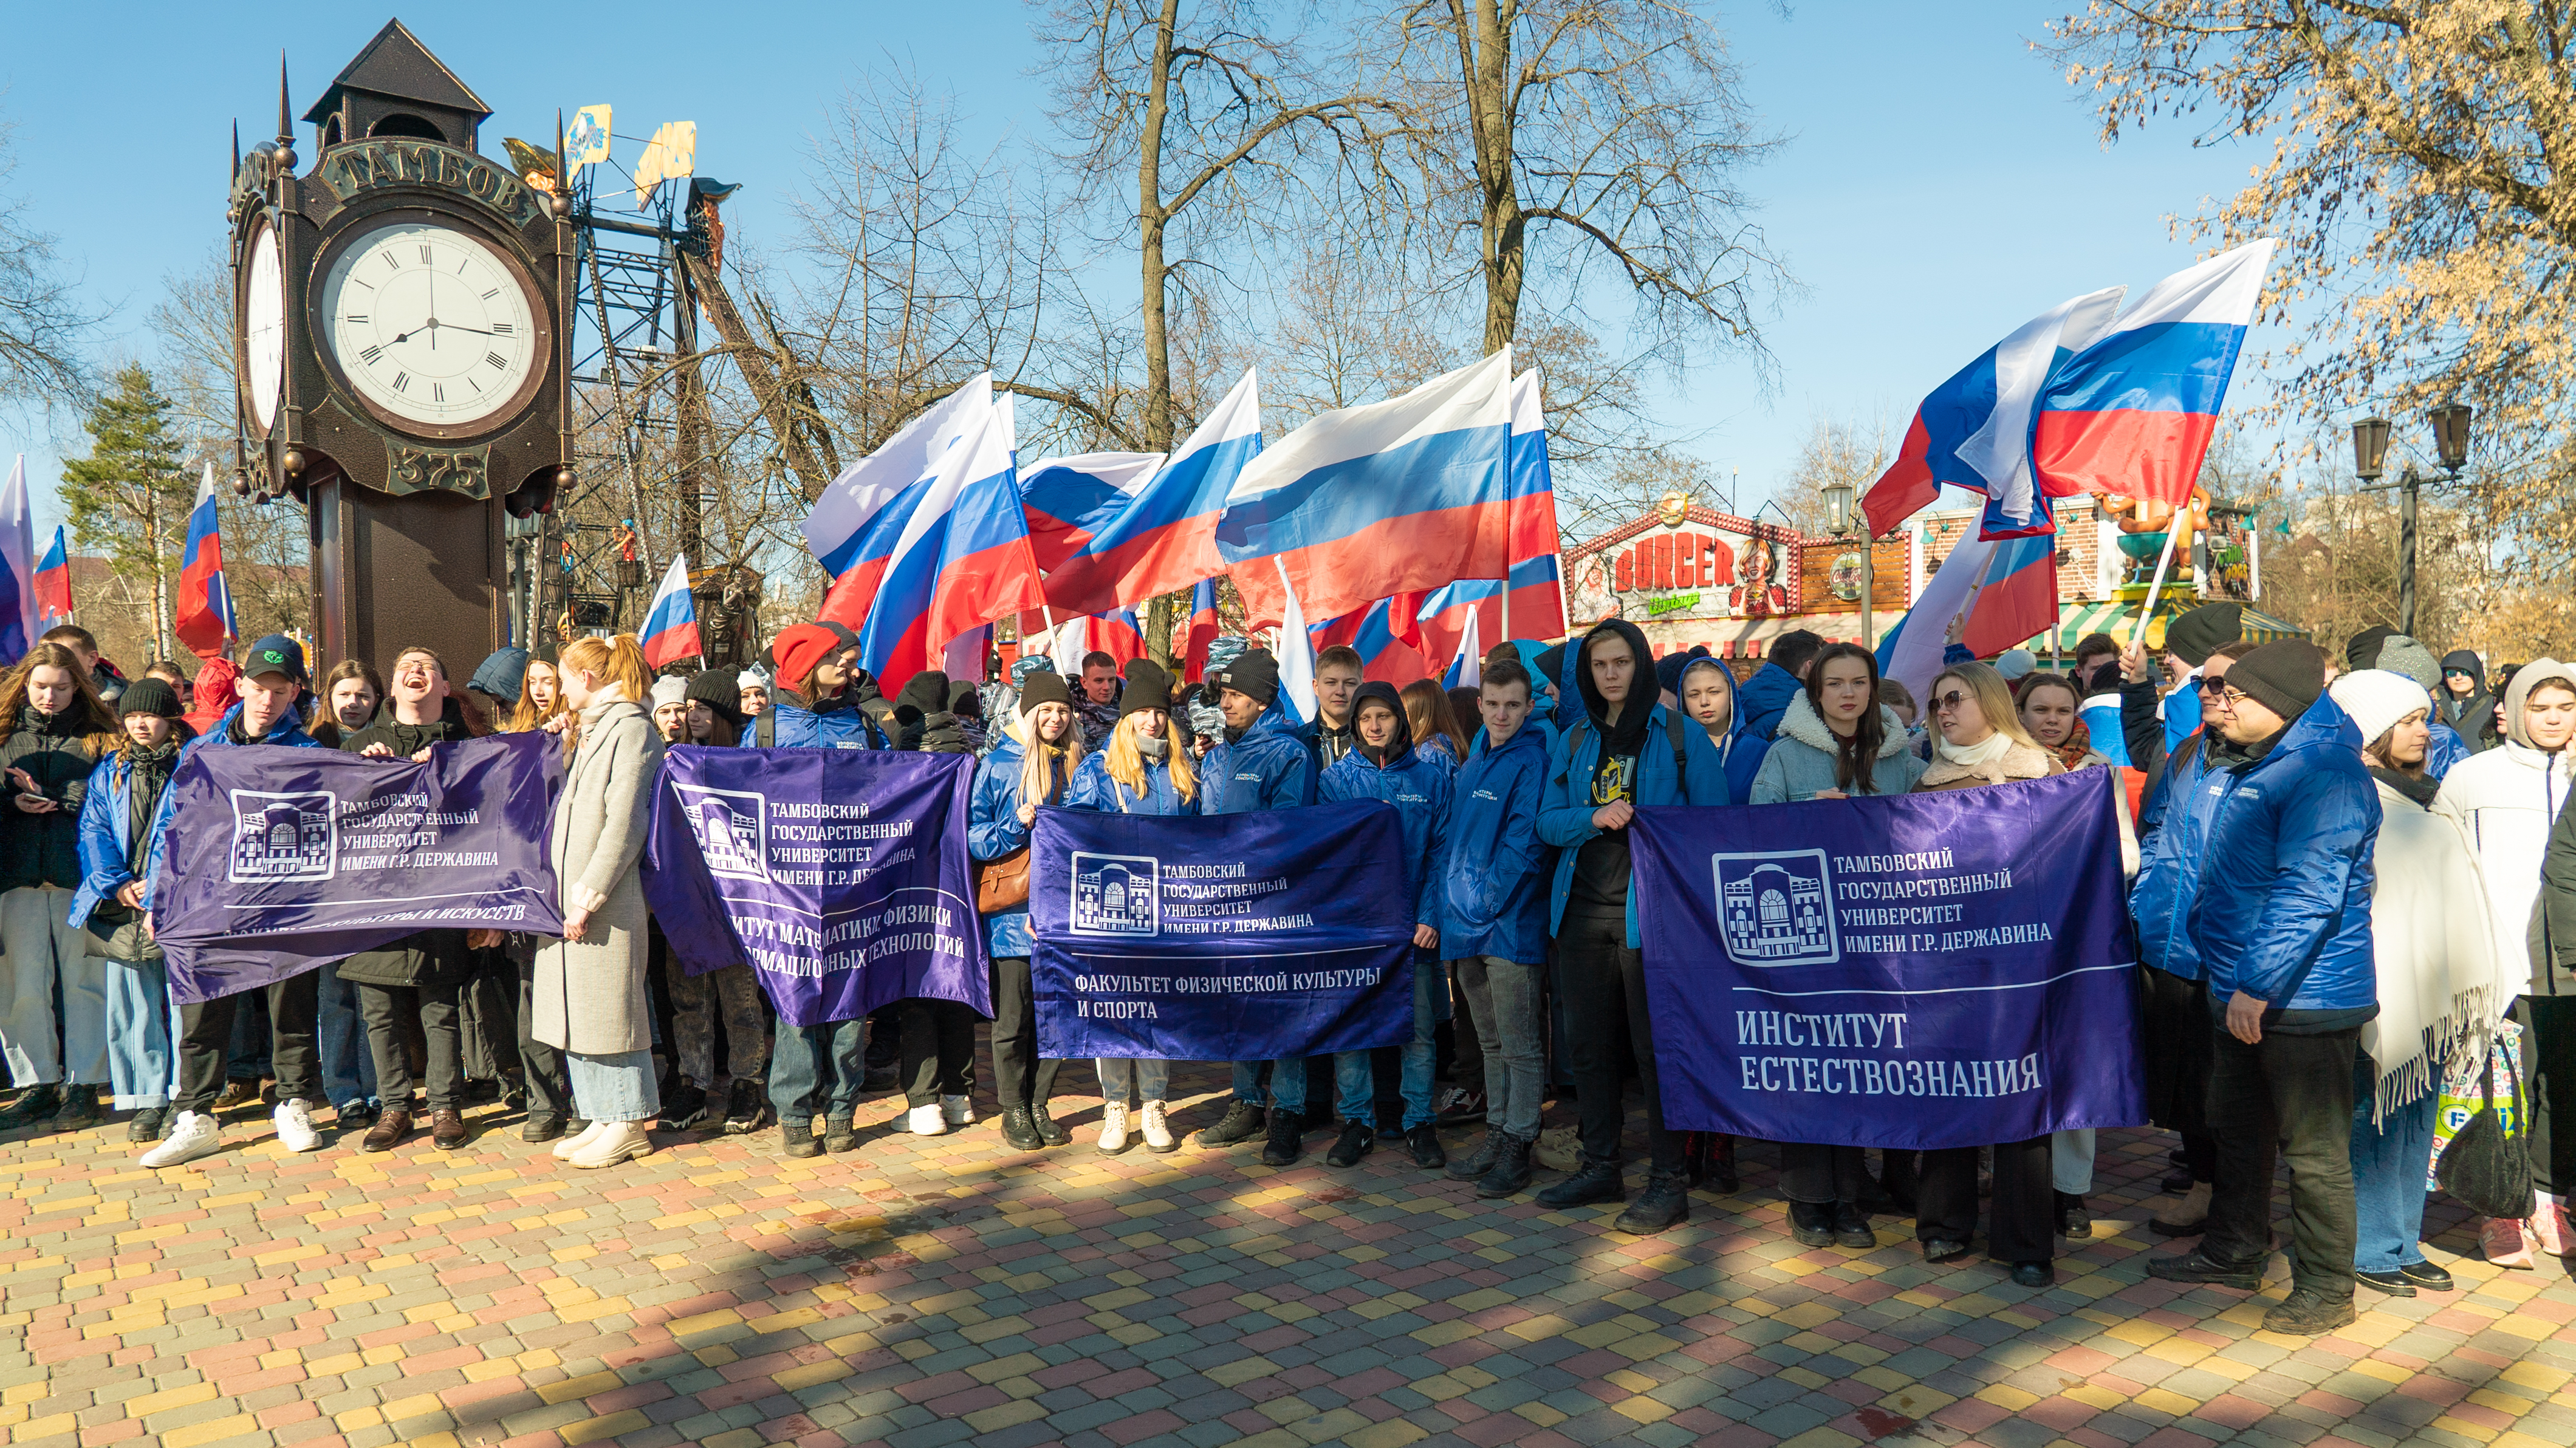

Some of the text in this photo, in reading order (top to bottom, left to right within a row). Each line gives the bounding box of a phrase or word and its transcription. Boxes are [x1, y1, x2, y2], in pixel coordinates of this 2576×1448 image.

[332, 145, 521, 213] ТАМБОВ
[397, 447, 477, 488] 375
[1615, 531, 1736, 593] BURGER
[2225, 563, 2248, 582] DOGS
[341, 791, 428, 814] ТАМБОВСКИЙ
[770, 802, 869, 819] ТАМБОВСКИЙ
[343, 808, 479, 829] ГОСУДАРСТВЕННЫЙ
[771, 819, 914, 842] ГОСУДАРСТВЕННЫЙ
[341, 852, 499, 872] ИМЕНИ Г.Р. ДЕРЖАВИНА
[771, 847, 872, 863] УНИВЕРСИТЕТ
[1834, 846, 1954, 873] ТАМБОВСКИЙ
[772, 869, 824, 886] ИМЕНИ
[828, 870, 849, 886] Г.Р.
[1163, 861, 1245, 879] ТАМБОВСКИЙ
[1163, 876, 1288, 900] ГОСУДАРСТВЕННЫЙ
[1837, 867, 2013, 901] ГОСУДАРСТВЕННЫЙ
[420, 909, 440, 920] И
[436, 904, 526, 921] ИСКУССТВ
[883, 904, 952, 927] ФИЗИКИ
[1163, 900, 1252, 918] УНИВЕРСИТЕТ
[1840, 903, 1964, 926] УНИВЕРСИТЕТ
[1163, 913, 1314, 934] ИМЕНИ Г.Р. ДЕРЖАВИНА
[868, 932, 965, 963] ТЕХНОЛОГИЙ
[1845, 922, 2054, 953] ИМЕНИ Г.Р. ДЕРЖАВИНА
[1075, 967, 1382, 994] ФАКУЛЬТЕТ ФИЗИЧЕСКОЙ КУЛЬТУРЫ
[1077, 1000, 1159, 1019] И СПОРТА
[1735, 1011, 1907, 1049] ИНСТИТУТ
[1739, 1052, 2043, 1098] ЕСТЕСТВОЗНАНИЯ
